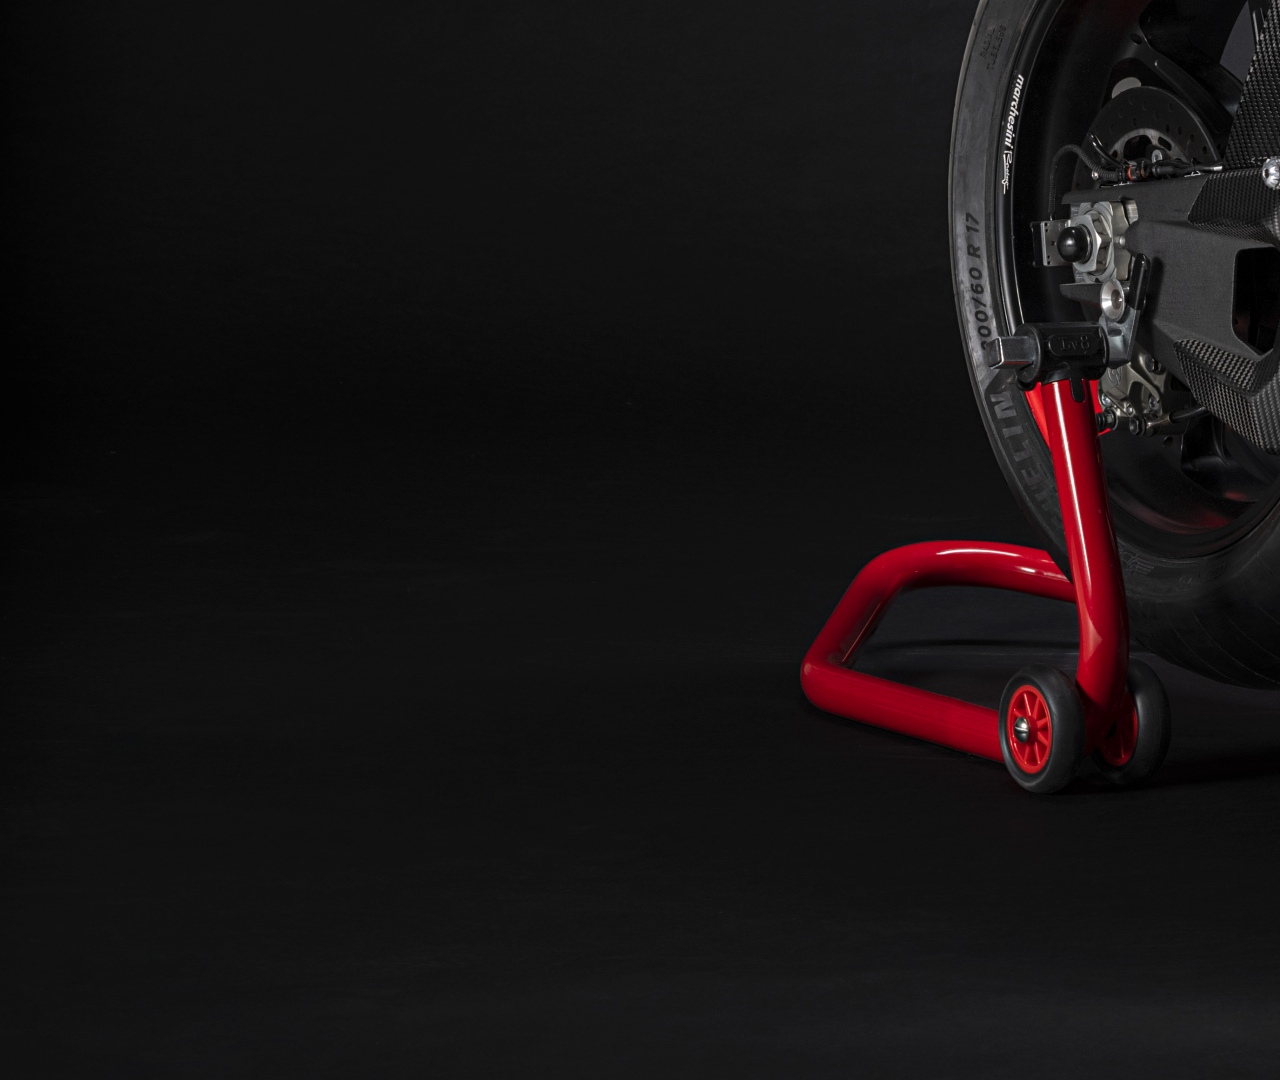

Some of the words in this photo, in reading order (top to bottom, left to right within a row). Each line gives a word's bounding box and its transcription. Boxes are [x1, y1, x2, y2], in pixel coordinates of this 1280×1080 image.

[1004, 74, 1024, 149] marchesini
[1001, 150, 1013, 195] Racing
[965, 211, 980, 234] 17
[966, 244, 982, 260] R
